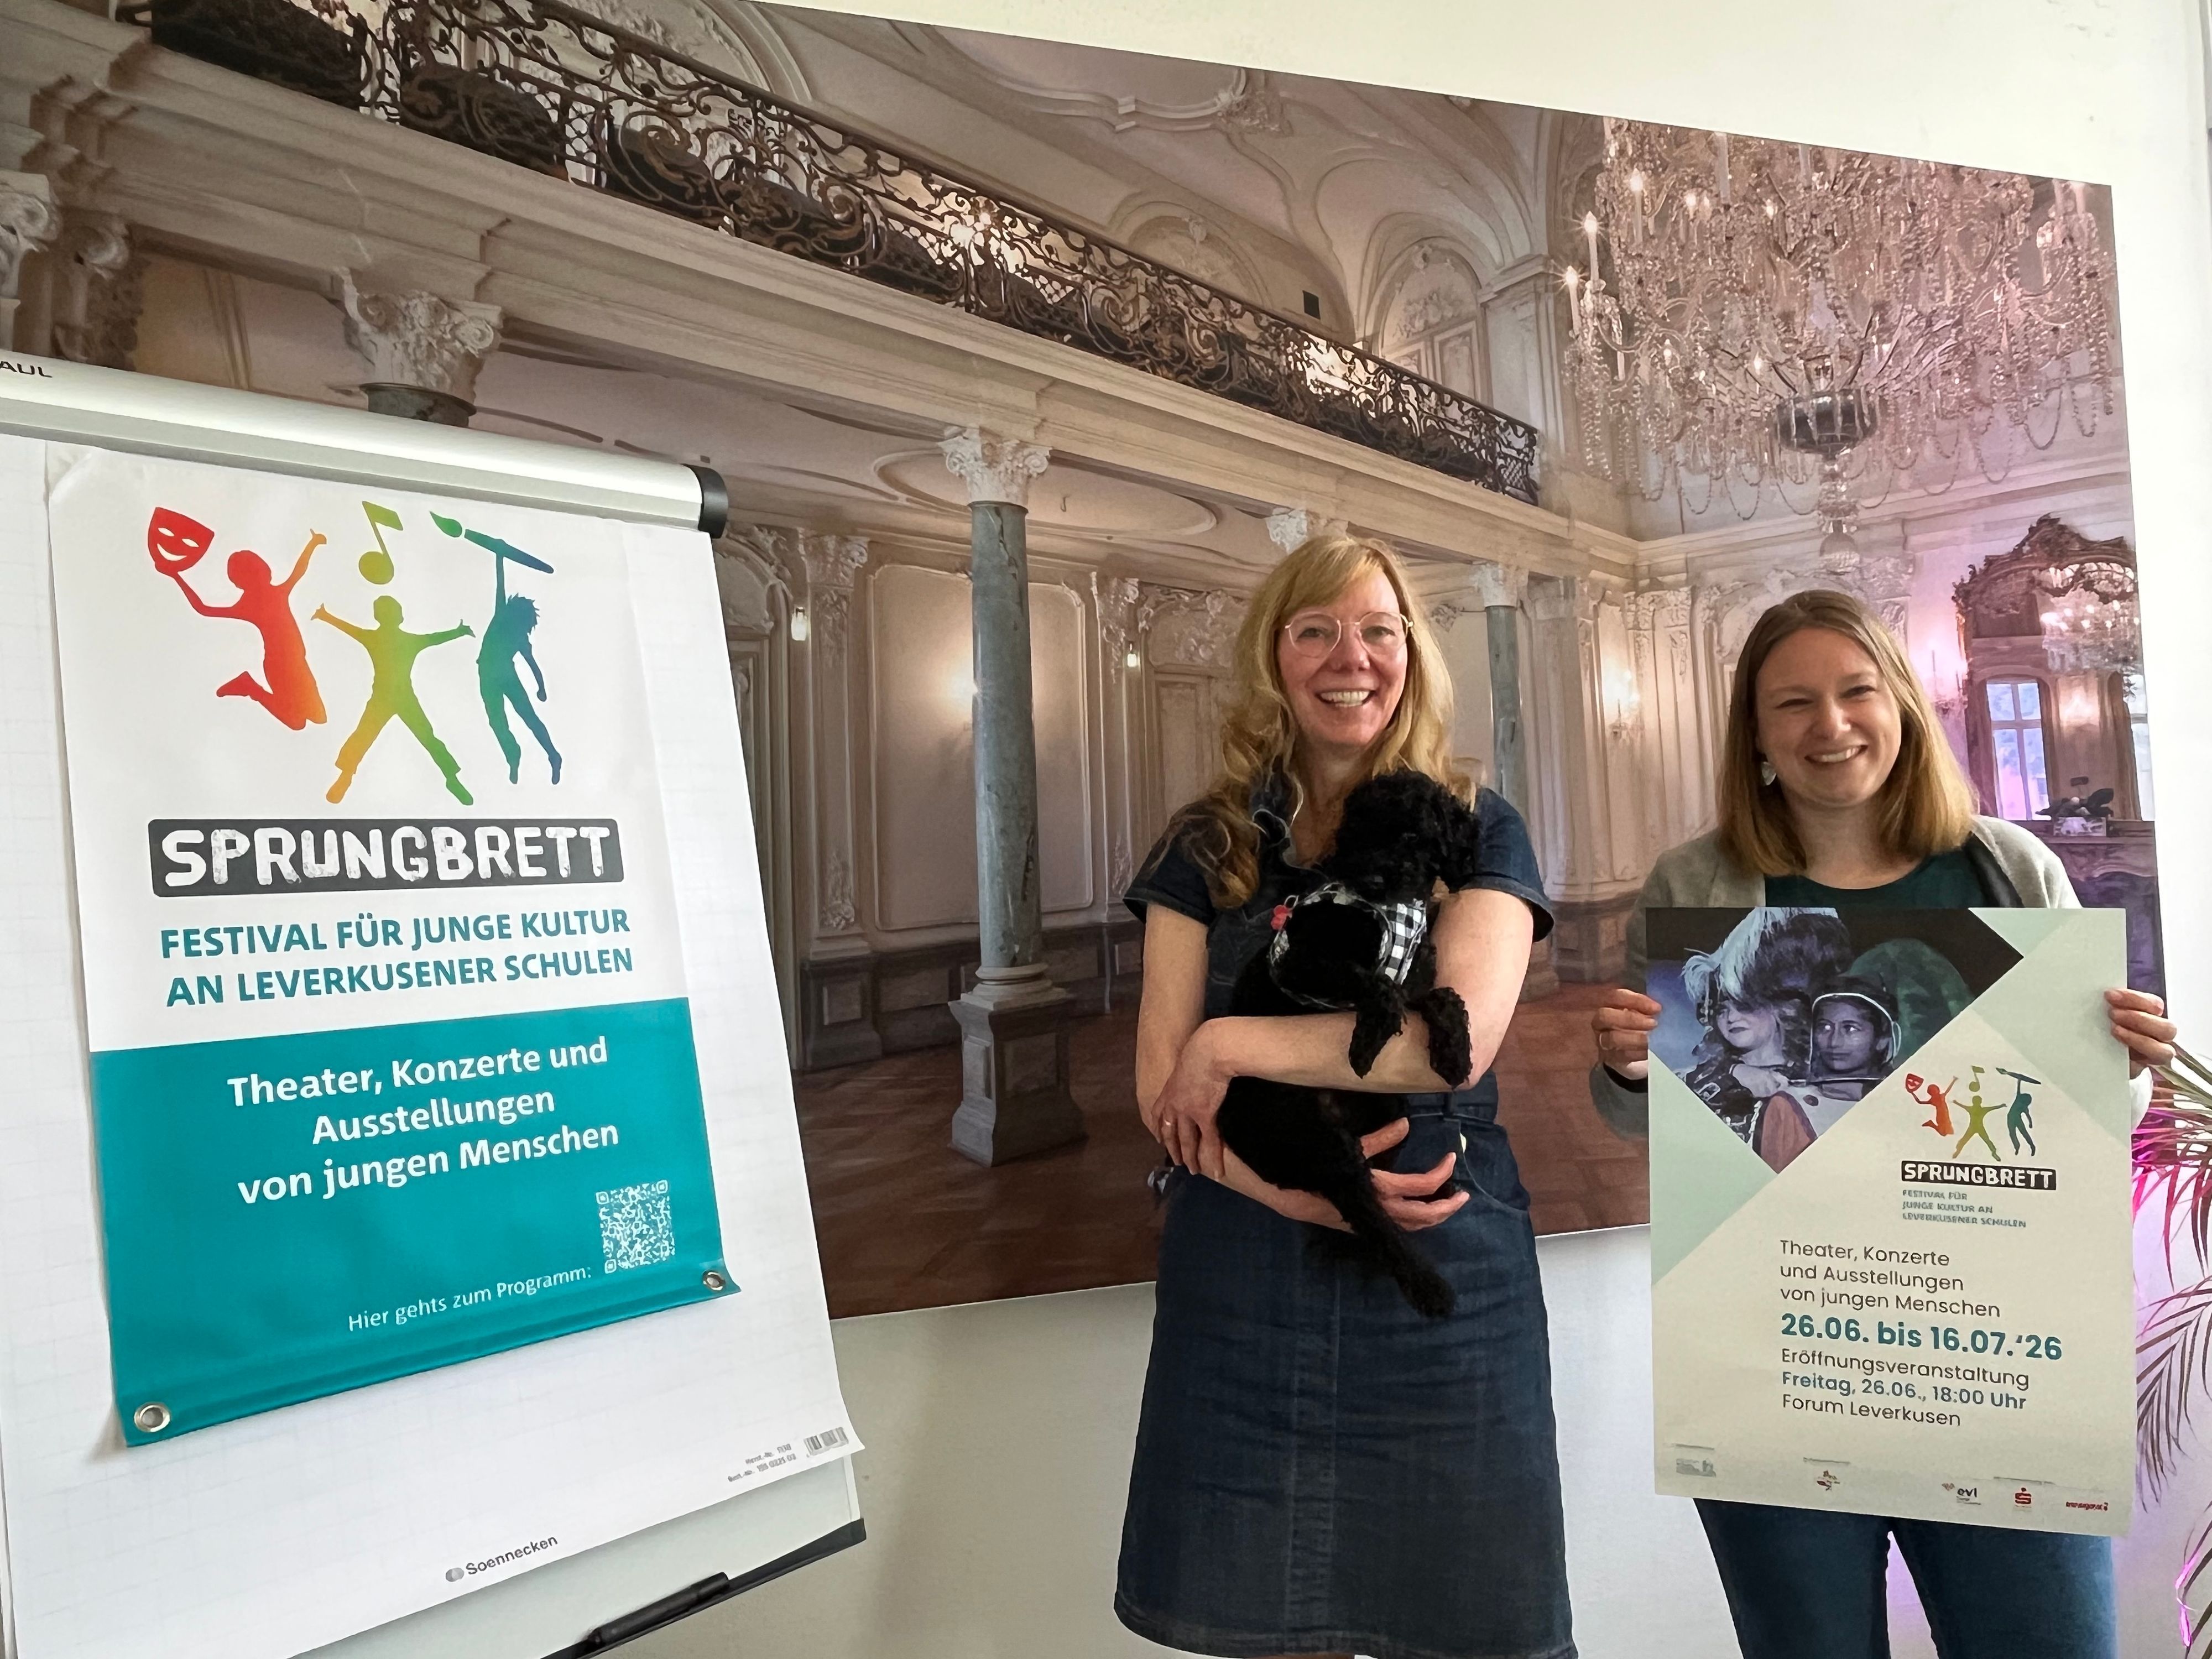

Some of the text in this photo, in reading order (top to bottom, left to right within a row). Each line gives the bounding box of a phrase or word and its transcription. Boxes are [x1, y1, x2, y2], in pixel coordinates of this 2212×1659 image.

[161, 826, 609, 887] SPRUNGBRETT
[160, 908, 630, 958] FESTIVAL FÜR JUNGE KULTUR
[166, 948, 633, 1007] AN LEVERKUSENER SCHULEN
[227, 1035, 607, 1106] Theater, Konzerte und
[311, 1091, 555, 1144] Ausstellungen
[237, 1124, 619, 1204] von jungen Menschen
[1904, 1164, 2053, 1188] SPRUNGBRETT
[1780, 1240, 1949, 1266] Theater, Konzerte
[348, 1264, 592, 1331] Hier gehts zum Programm:
[1780, 1264, 1964, 1293] und Ausstellungen
[1780, 1287, 2000, 1317] von jungen Menschen
[1781, 1313, 1869, 1343] 26.06.
[1878, 1321, 1922, 1347] bis
[1782, 1348, 2029, 1391] Eröffnungsveranstaltung
[1782, 1372, 2026, 1408] Freitag, 26.06., 18:00 Uhr
[1783, 1394, 1960, 1426] Forum Leverkusen
[466, 1536, 557, 1574] Soennecken
